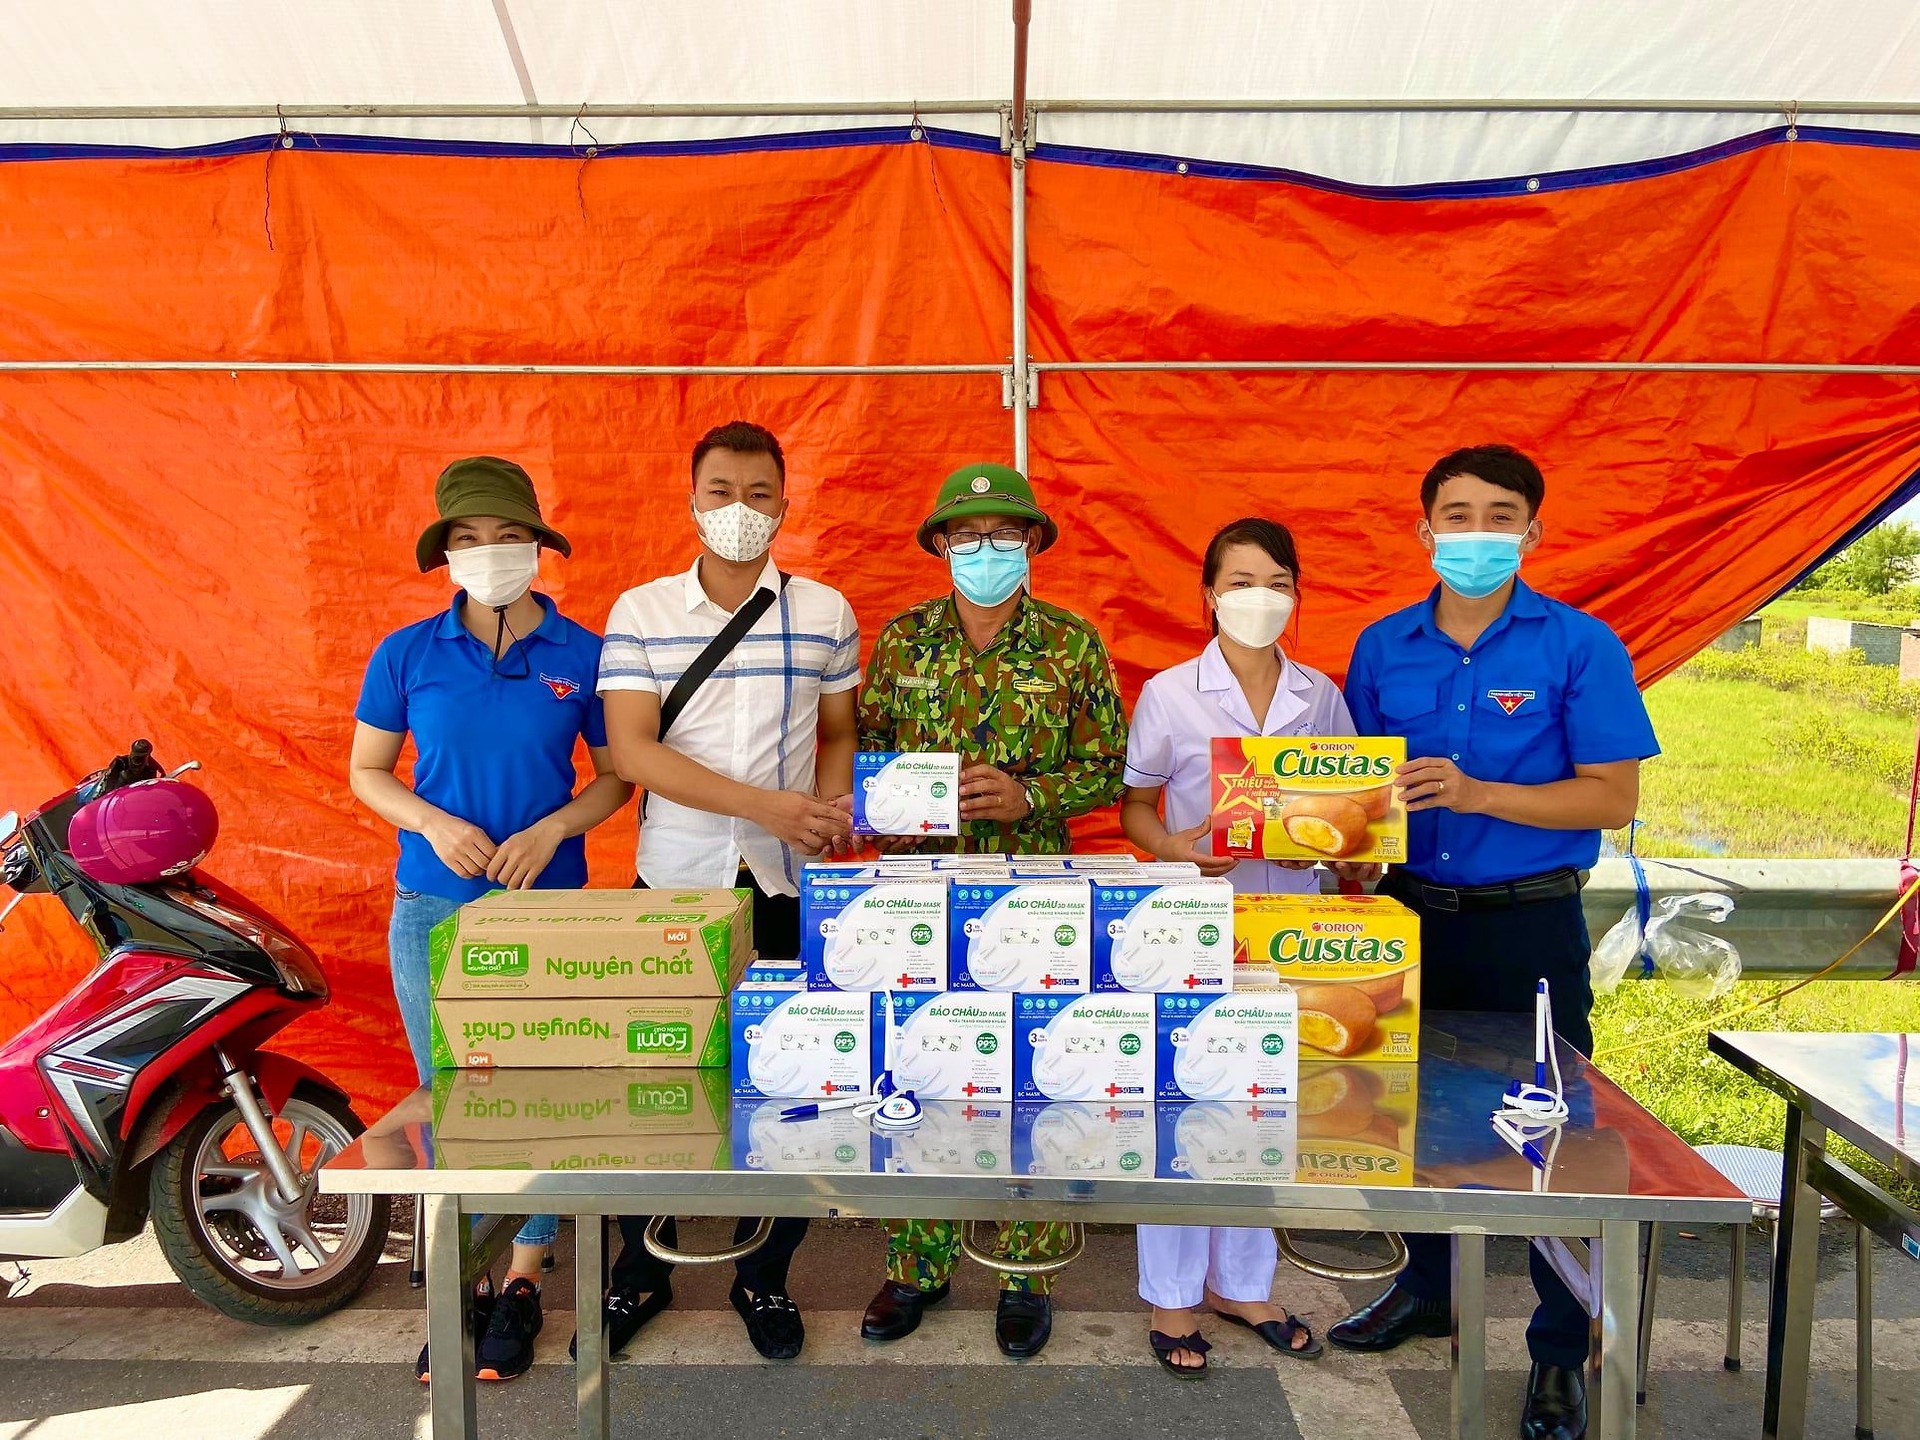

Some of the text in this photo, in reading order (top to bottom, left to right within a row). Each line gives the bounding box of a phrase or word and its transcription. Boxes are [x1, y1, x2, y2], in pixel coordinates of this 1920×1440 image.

[1320, 743, 1355, 751] ORION
[1272, 748, 1392, 777] Custas
[864, 780, 870, 788] 3
[647, 914, 700, 922] Fami
[822, 924, 828, 933] 3
[966, 924, 972, 933] 3
[1109, 924, 1116, 934] 3
[1324, 924, 1363, 932] ORION
[912, 930, 931, 939] 99%
[1056, 931, 1076, 940] 99%
[1200, 931, 1218, 940] 99%
[1268, 929, 1405, 962] Custas
[468, 946, 518, 965] Fami
[546, 948, 693, 980] Nguyên Chất
[462, 1016, 610, 1048] Nguyên Chất
[746, 1030, 753, 1039] 3
[1030, 1033, 1037, 1043] 3
[1172, 1032, 1179, 1042] 3
[636, 1033, 687, 1051] Fami
[836, 1038, 854, 1047] 99%
[978, 1040, 996, 1049] 99%
[1120, 1041, 1140, 1049] 99%
[1263, 1041, 1282, 1050] 99%
